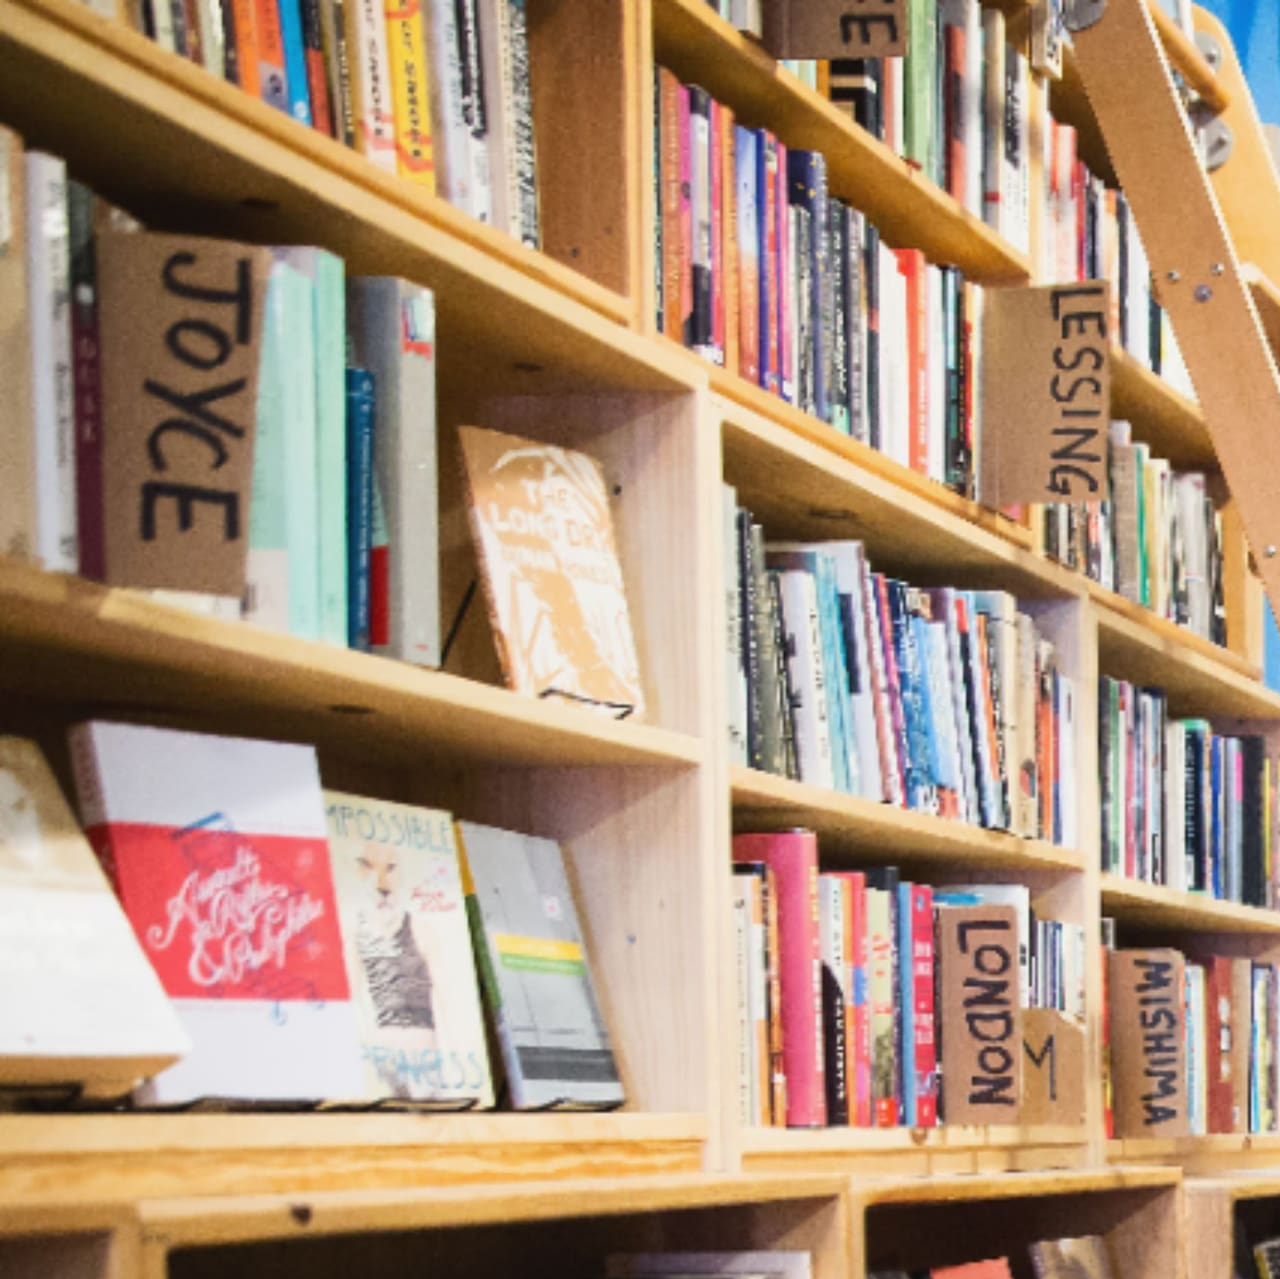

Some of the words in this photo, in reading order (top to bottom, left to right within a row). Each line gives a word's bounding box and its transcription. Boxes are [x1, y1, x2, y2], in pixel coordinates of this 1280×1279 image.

[138, 250, 253, 542] JOYCE
[1045, 286, 1104, 498] LESSING
[325, 802, 454, 856] MPOSSIBLE
[957, 919, 1016, 1107] LONDON
[1132, 957, 1180, 1126] MISHIMA
